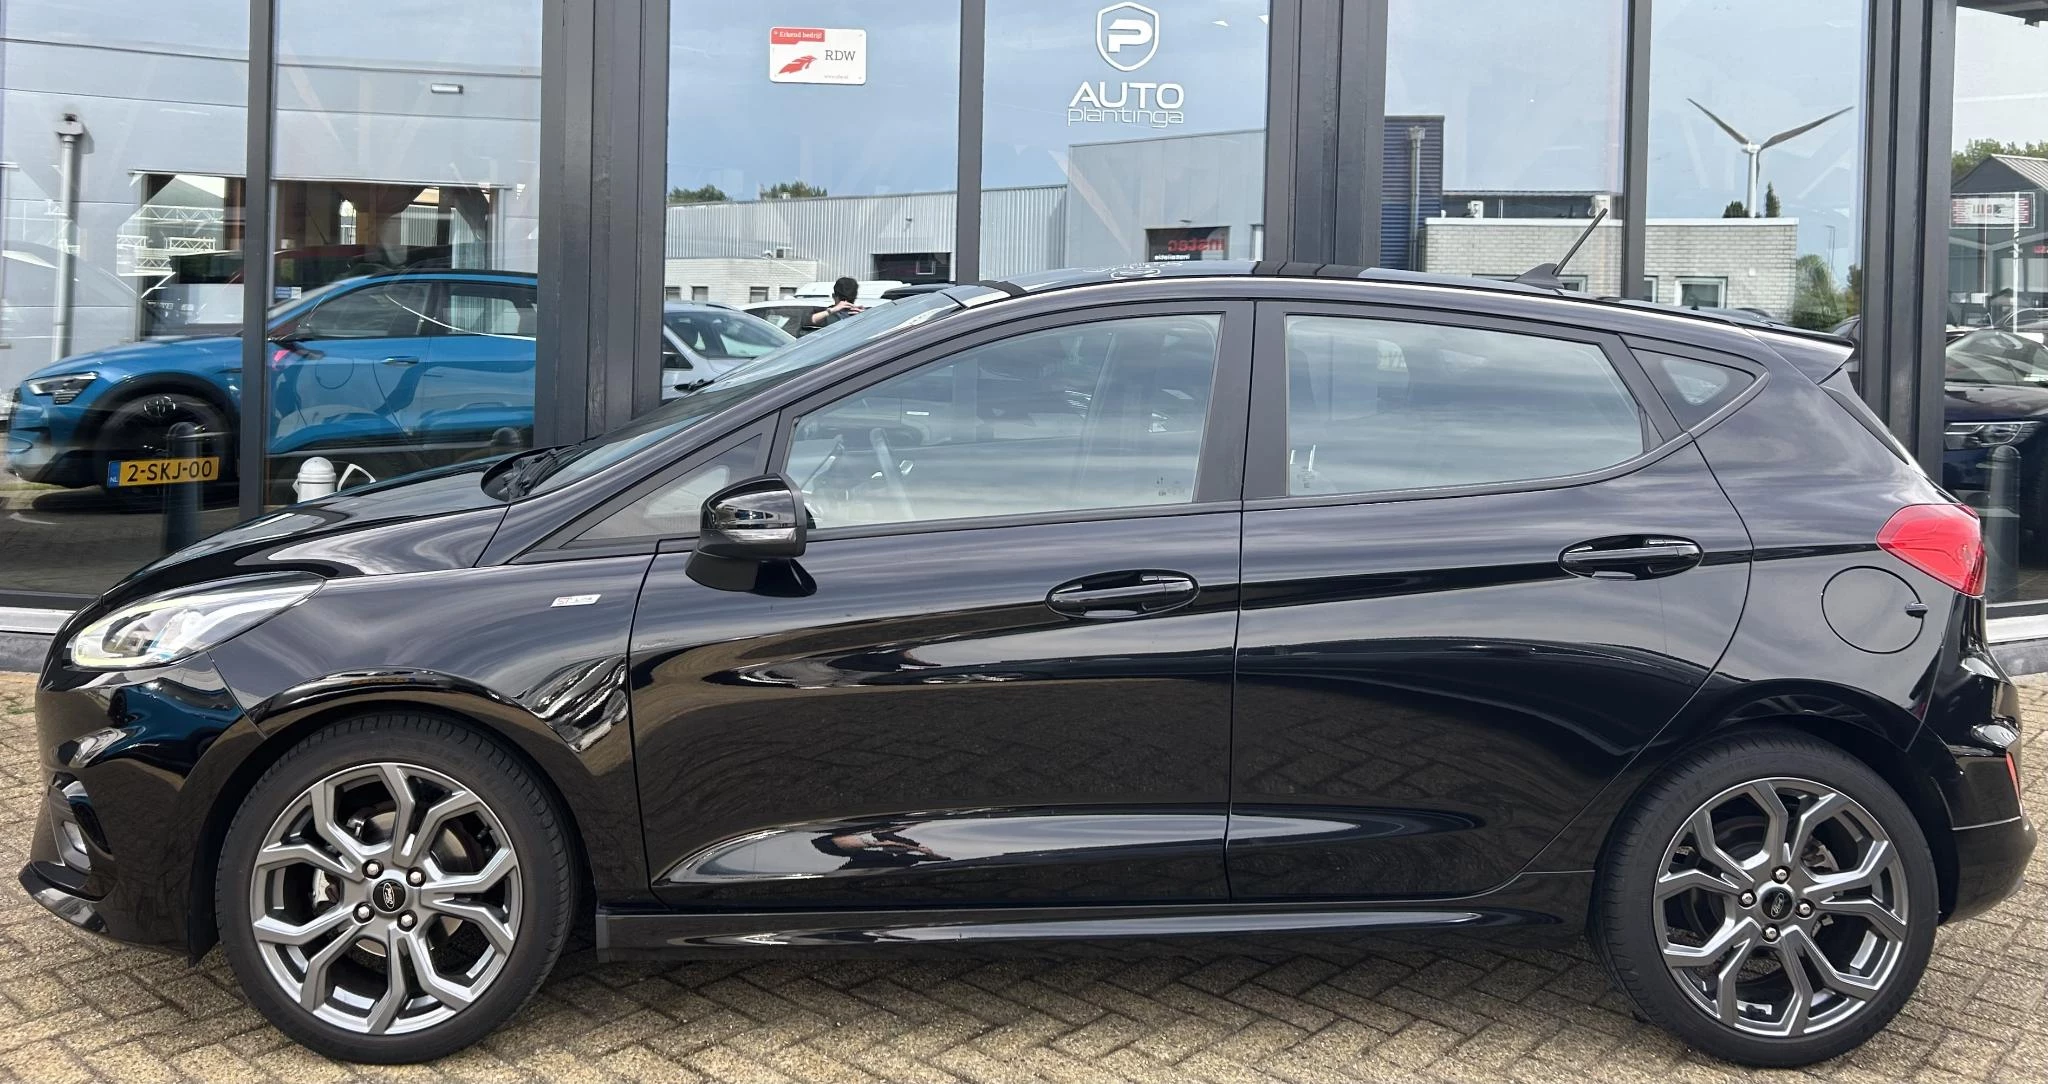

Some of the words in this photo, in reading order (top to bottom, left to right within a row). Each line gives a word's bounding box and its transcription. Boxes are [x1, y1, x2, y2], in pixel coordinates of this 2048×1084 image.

[825, 49, 856, 61] RDW
[1068, 81, 1184, 109] AUTO
[1067, 106, 1184, 128] plantinga
[127, 460, 212, 482] 2-SKJ-00
